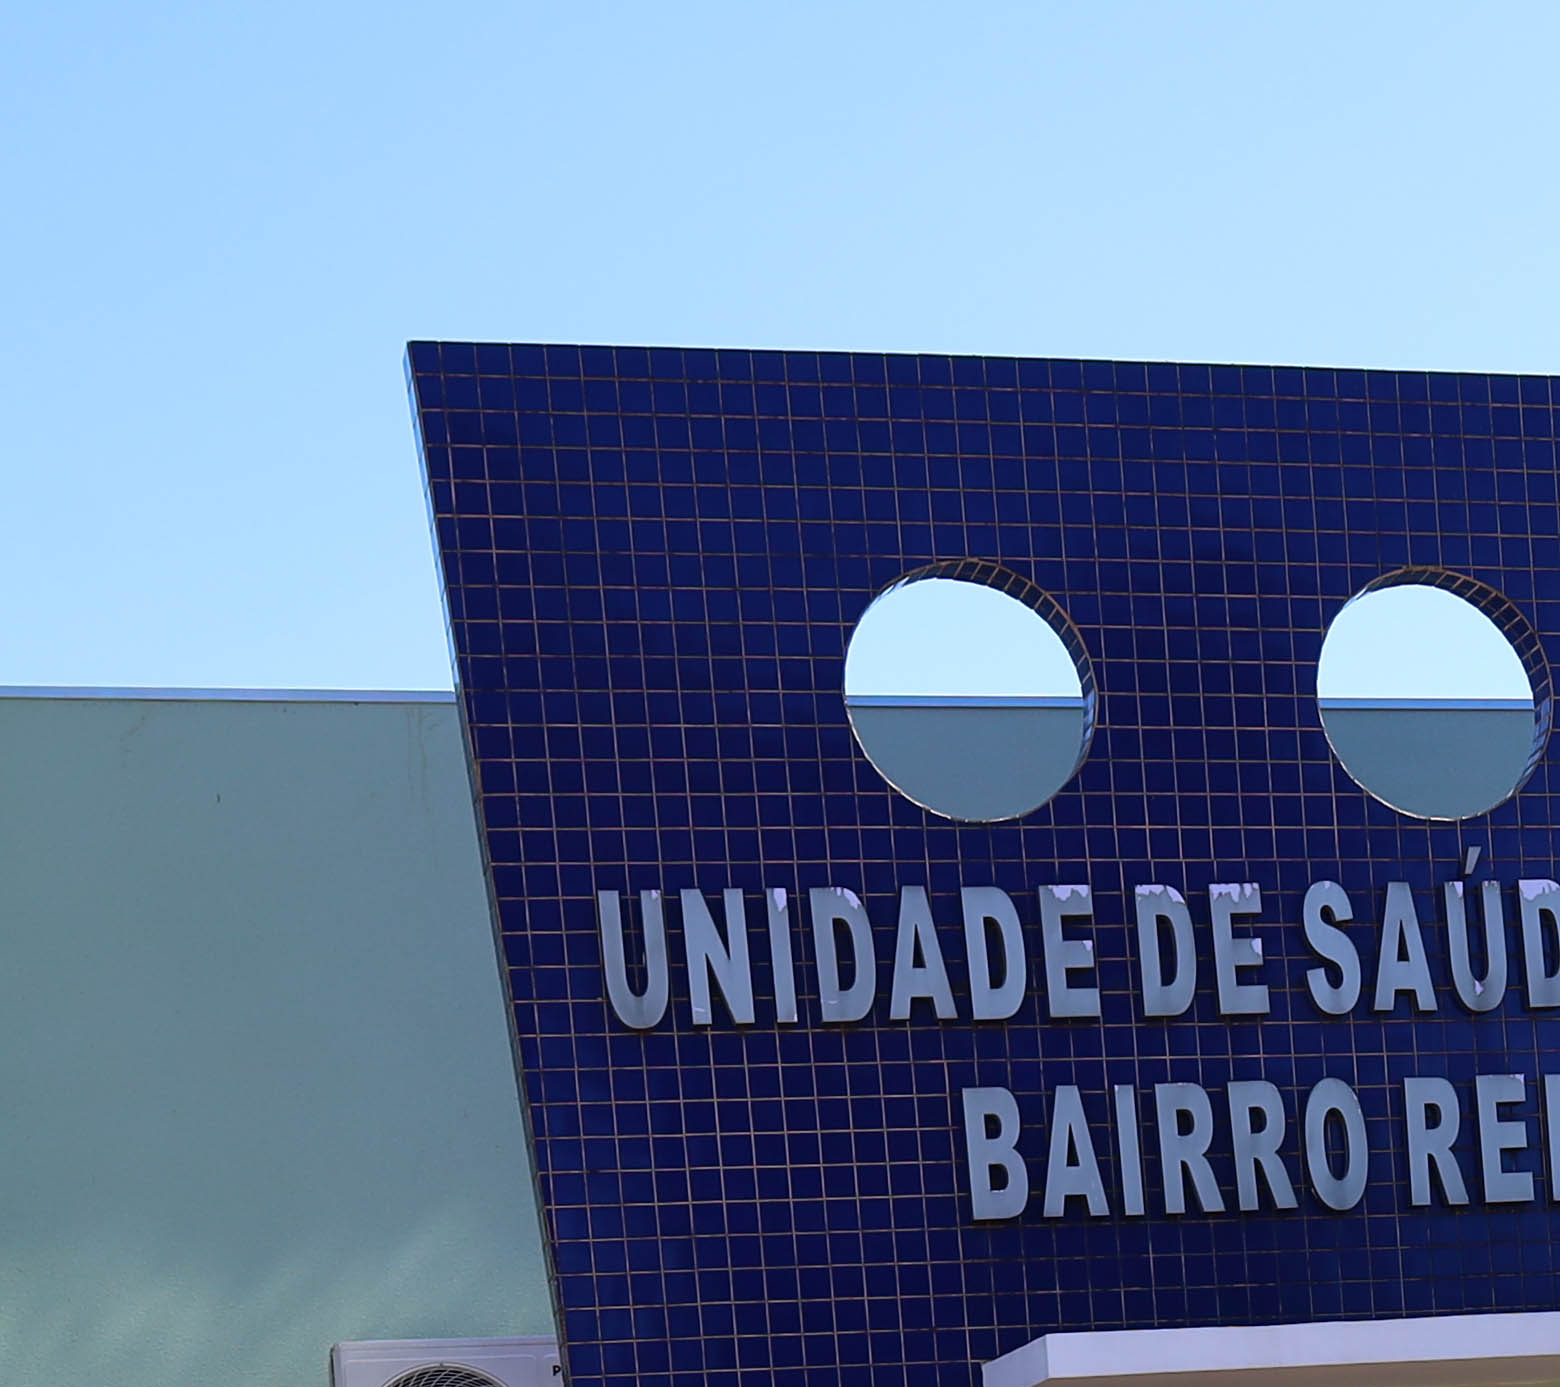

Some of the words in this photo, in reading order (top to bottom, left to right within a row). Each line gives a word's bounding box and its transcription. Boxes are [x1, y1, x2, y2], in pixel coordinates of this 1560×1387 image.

[597, 885, 1101, 1029] UNIDADE
[1134, 882, 1271, 1017] DE
[961, 1077, 1370, 1221] BAIRRO
